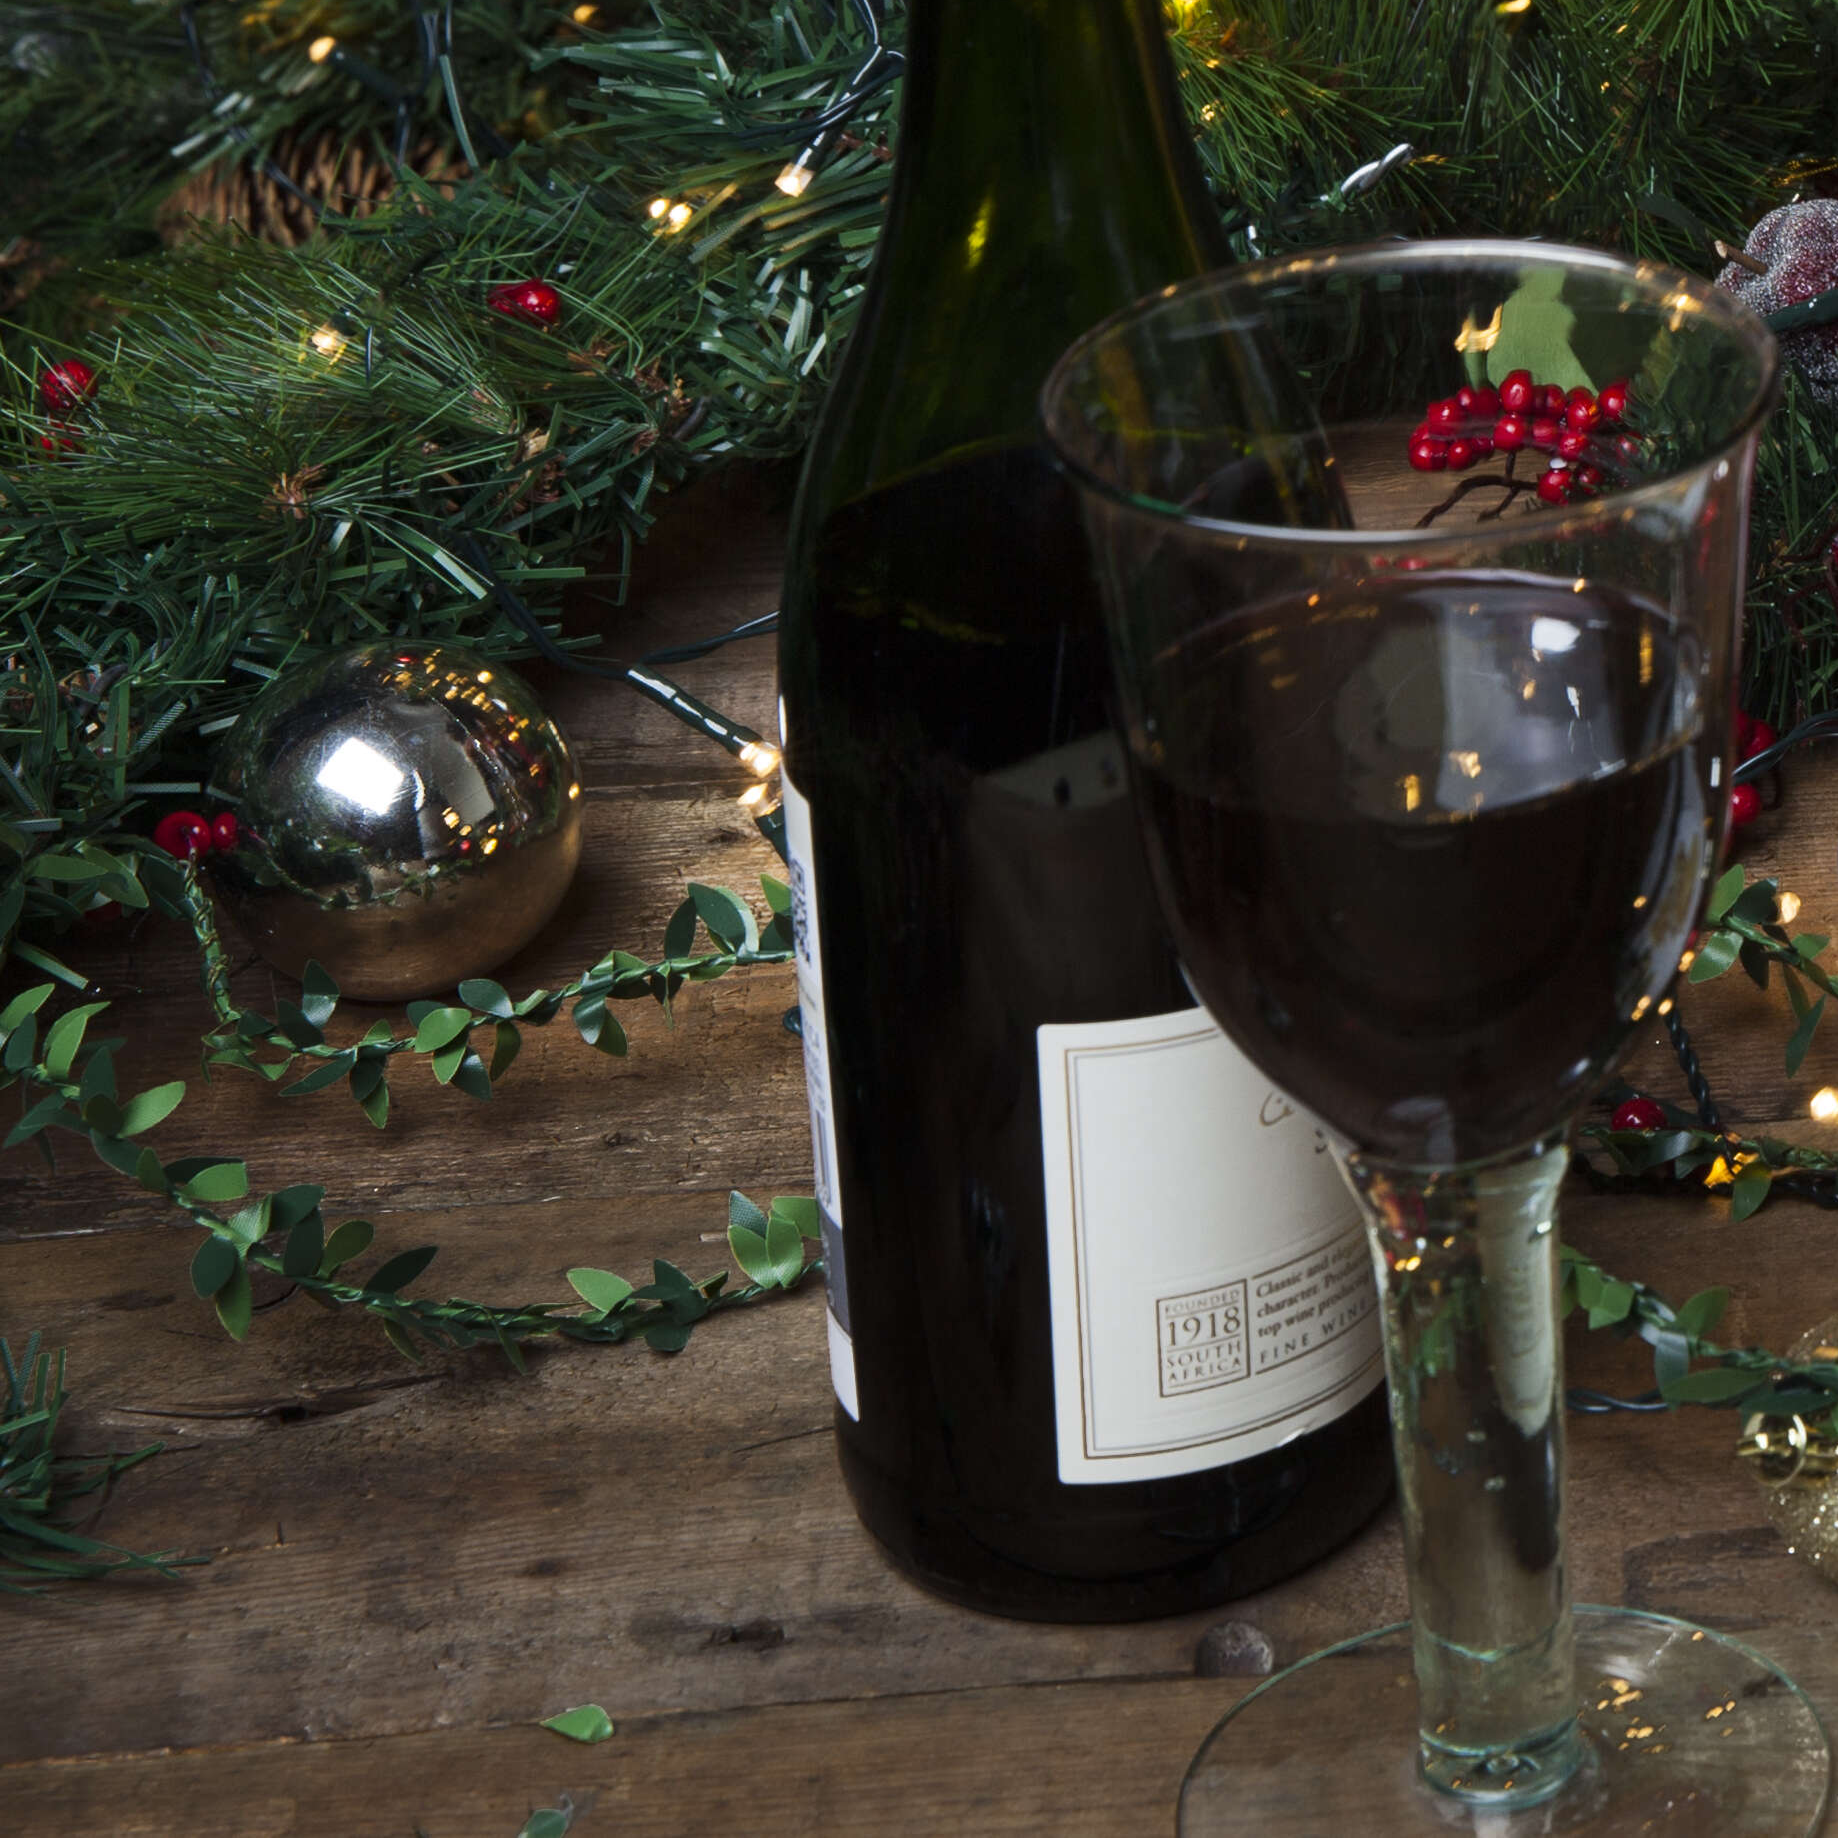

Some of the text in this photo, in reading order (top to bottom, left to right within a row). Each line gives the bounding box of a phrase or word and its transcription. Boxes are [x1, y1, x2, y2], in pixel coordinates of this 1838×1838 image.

[1167, 1306, 1241, 1346] 1918
[1167, 1340, 1241, 1370] SOUTH
[1260, 1333, 1310, 1365] FINE
[1168, 1357, 1241, 1383] AFRICA
